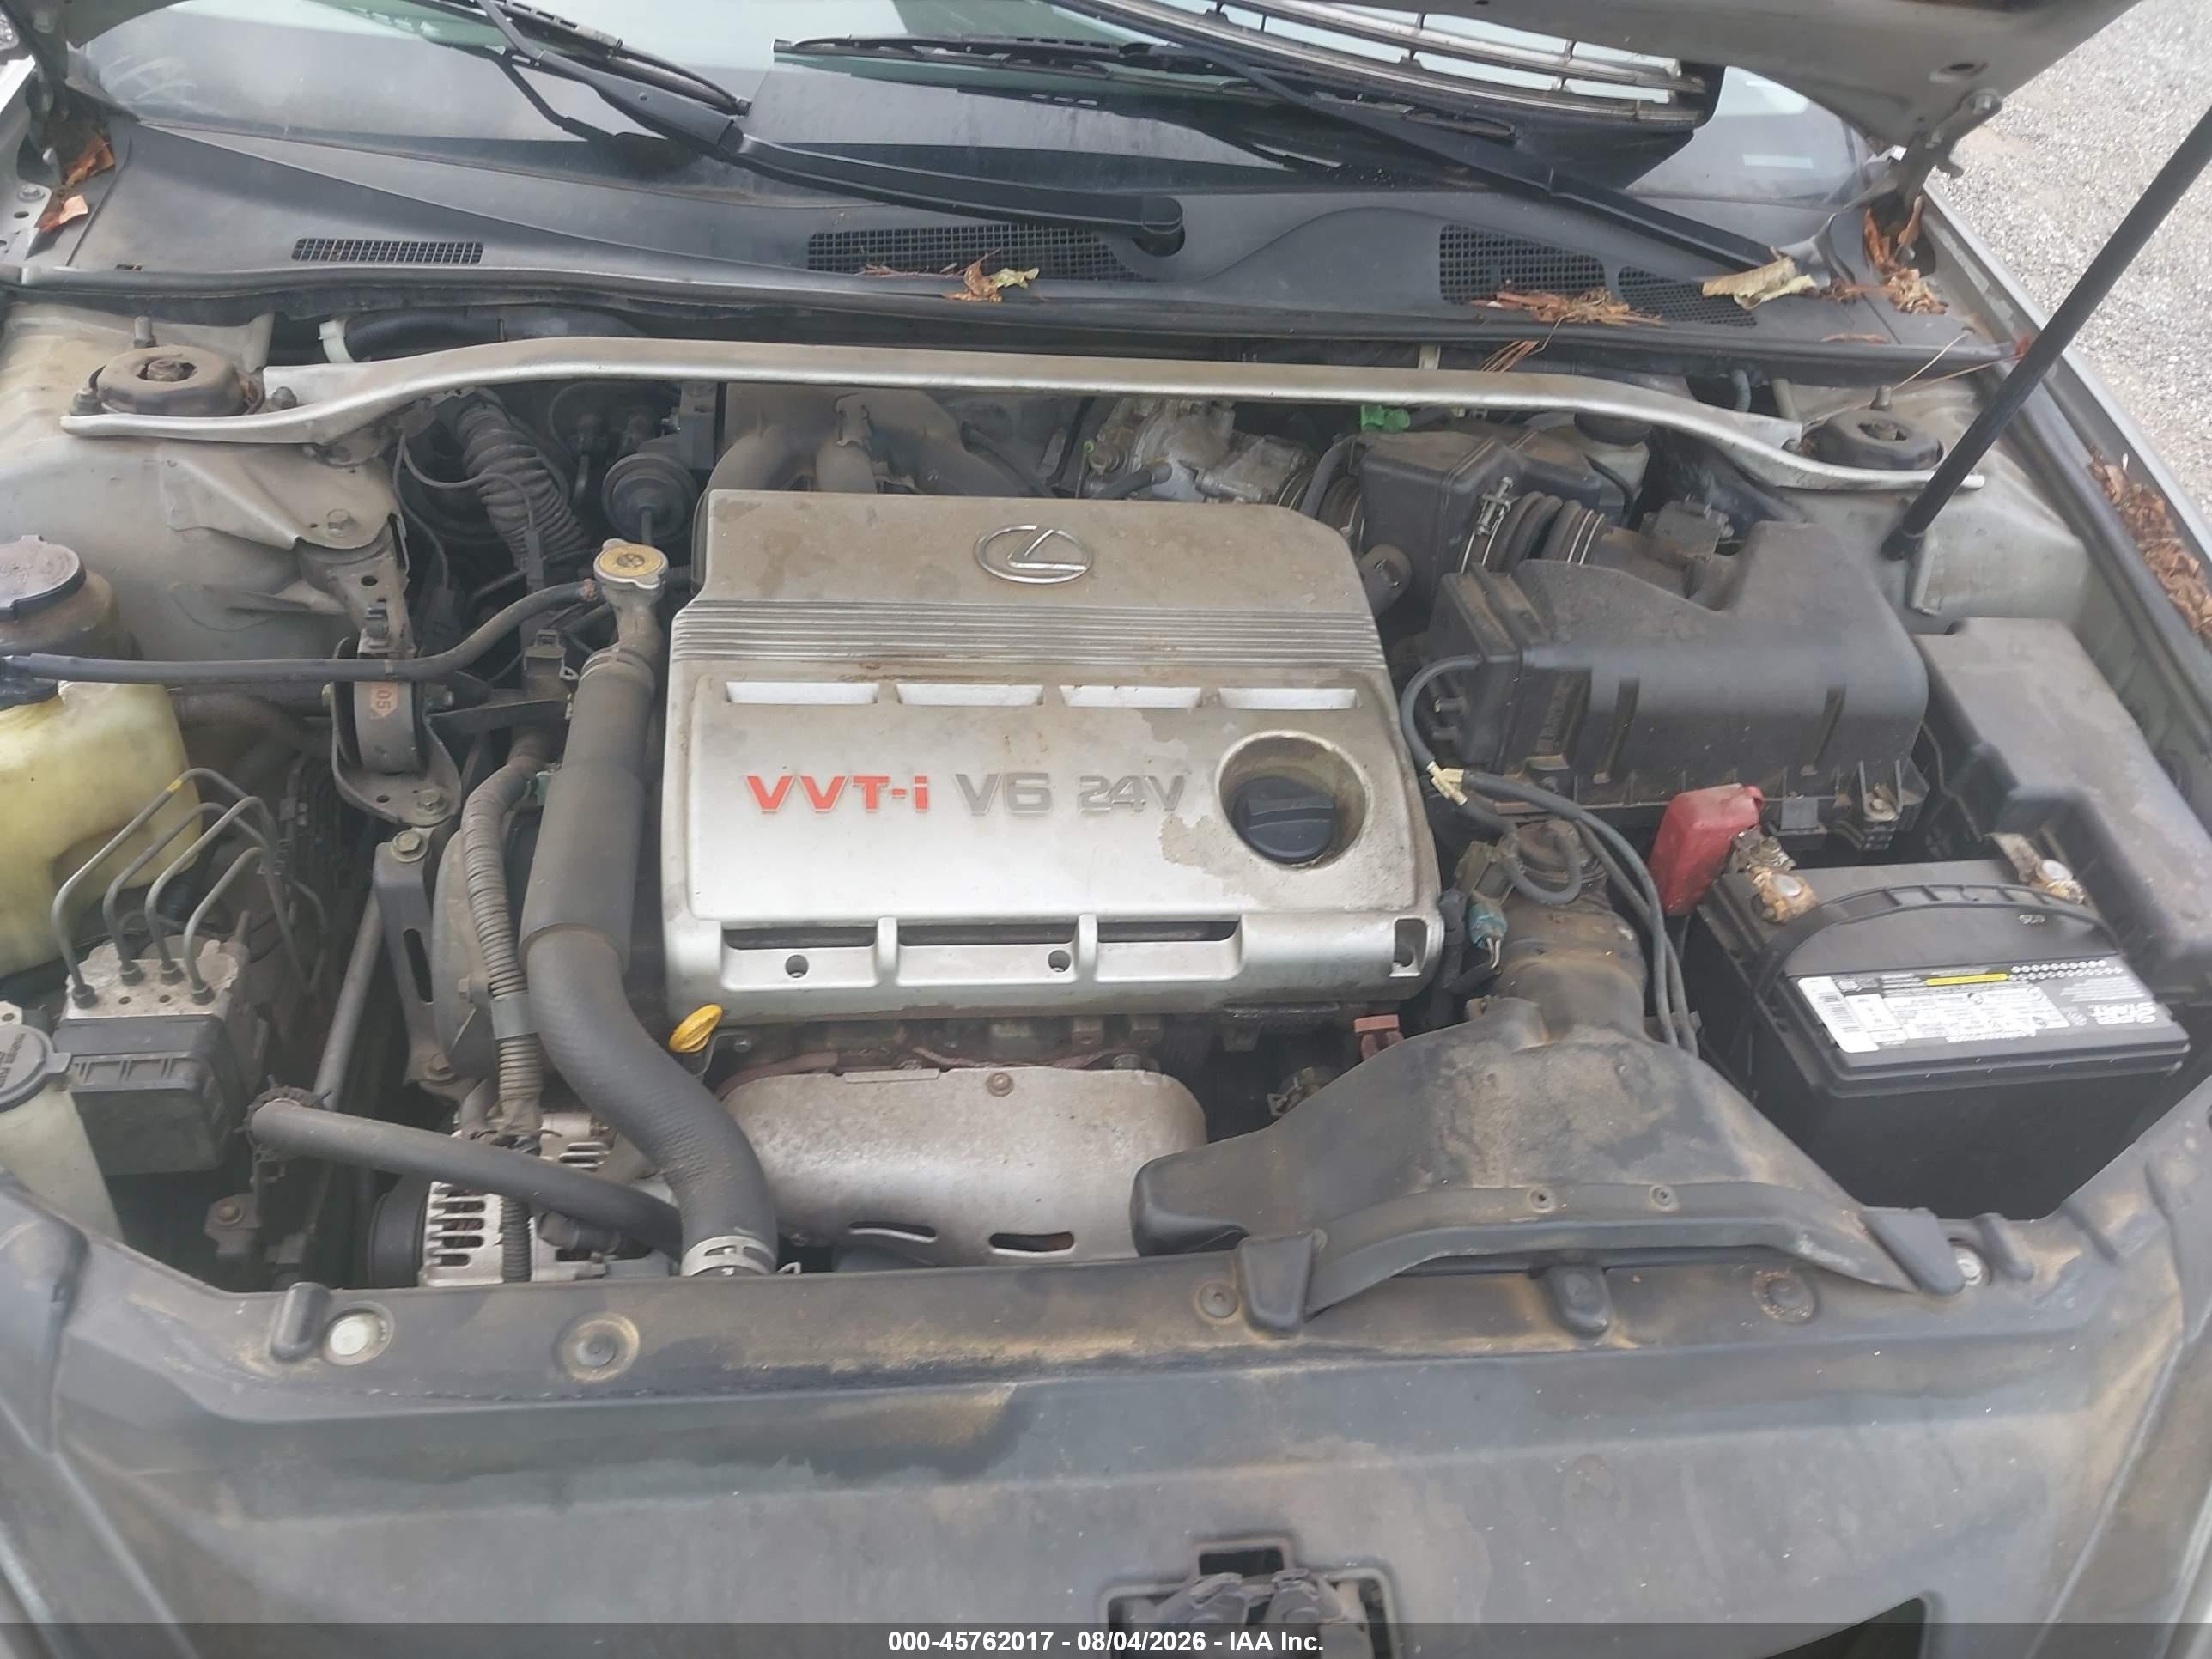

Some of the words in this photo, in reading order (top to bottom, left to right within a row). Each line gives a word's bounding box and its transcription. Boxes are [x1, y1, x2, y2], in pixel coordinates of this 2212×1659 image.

[745, 774, 931, 815] VVT-i
[954, 772, 1054, 816] V6
[1078, 775, 1185, 815] 24V
